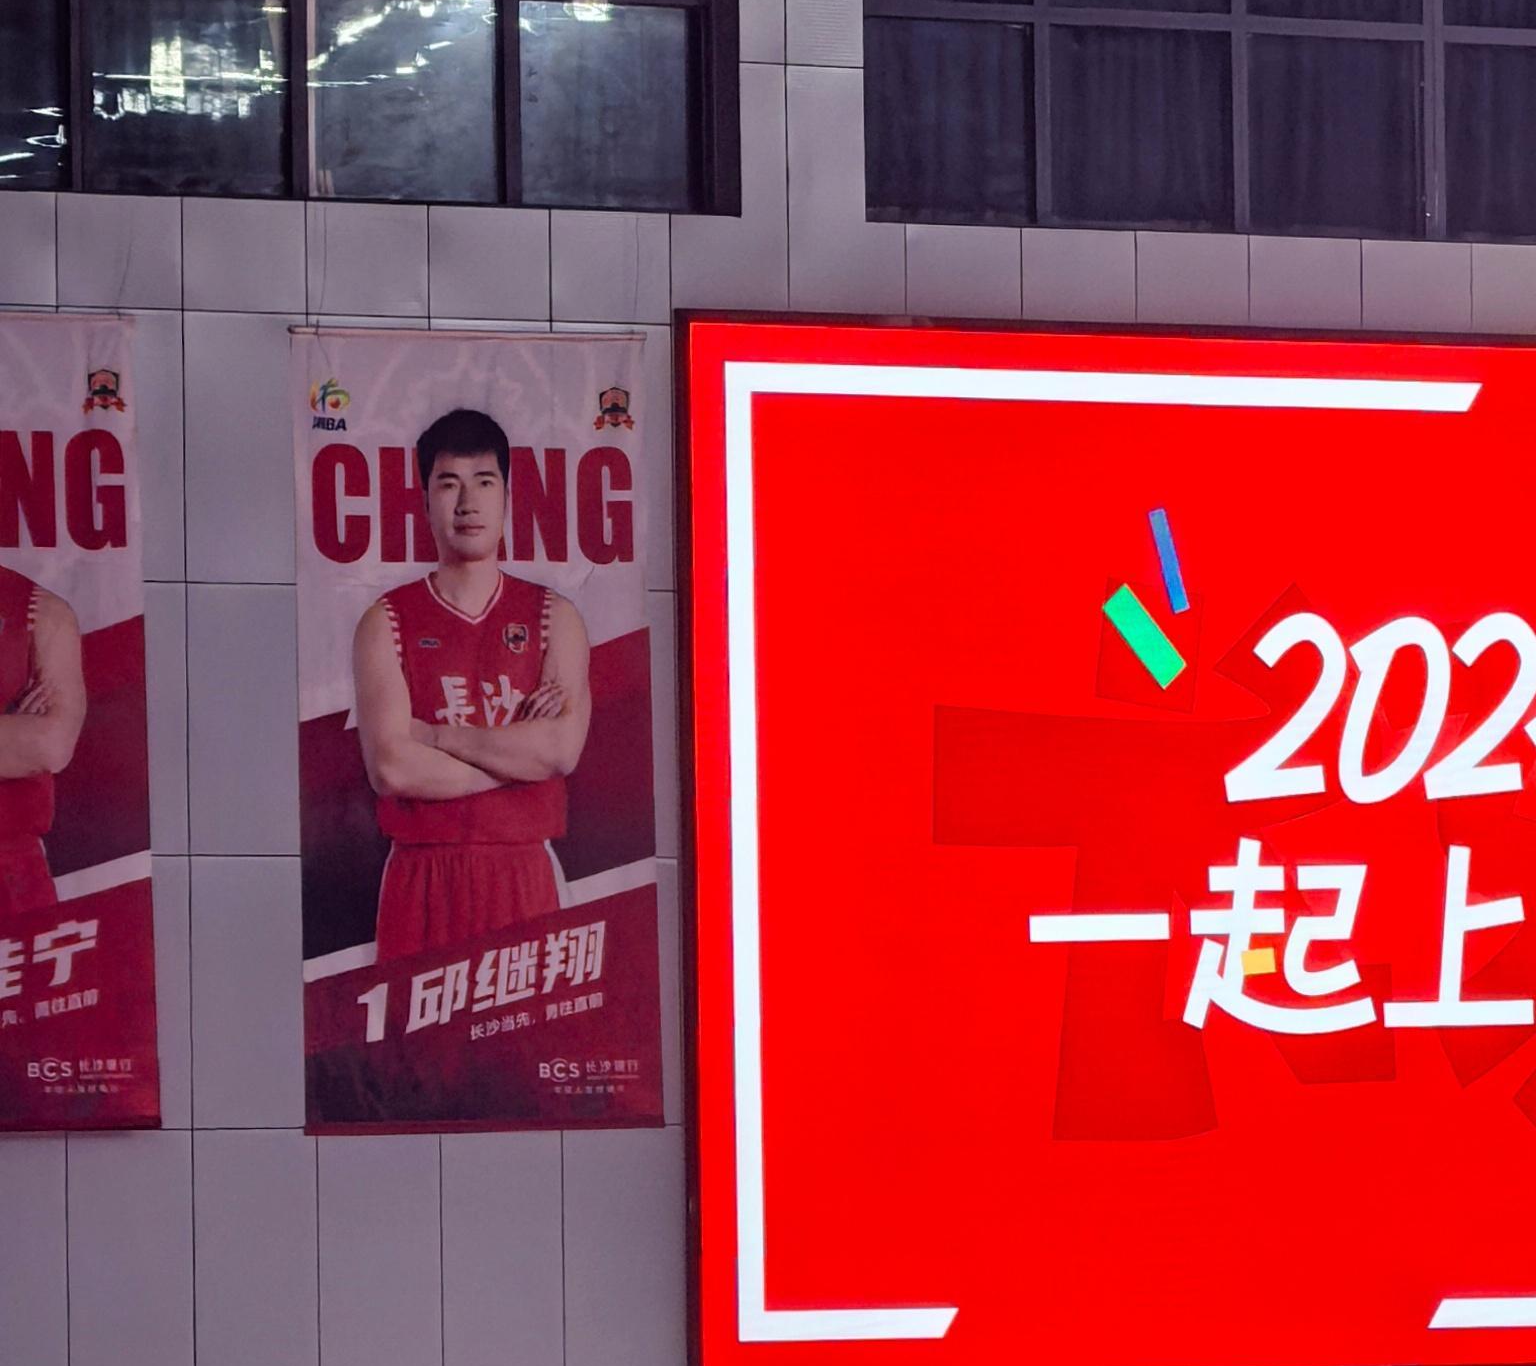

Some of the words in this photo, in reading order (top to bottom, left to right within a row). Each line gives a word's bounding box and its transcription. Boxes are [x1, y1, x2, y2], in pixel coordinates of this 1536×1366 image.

[312, 443, 634, 564] CHNG
[28, 1059, 72, 1080] BCS
[539, 1059, 580, 1081] BCS
